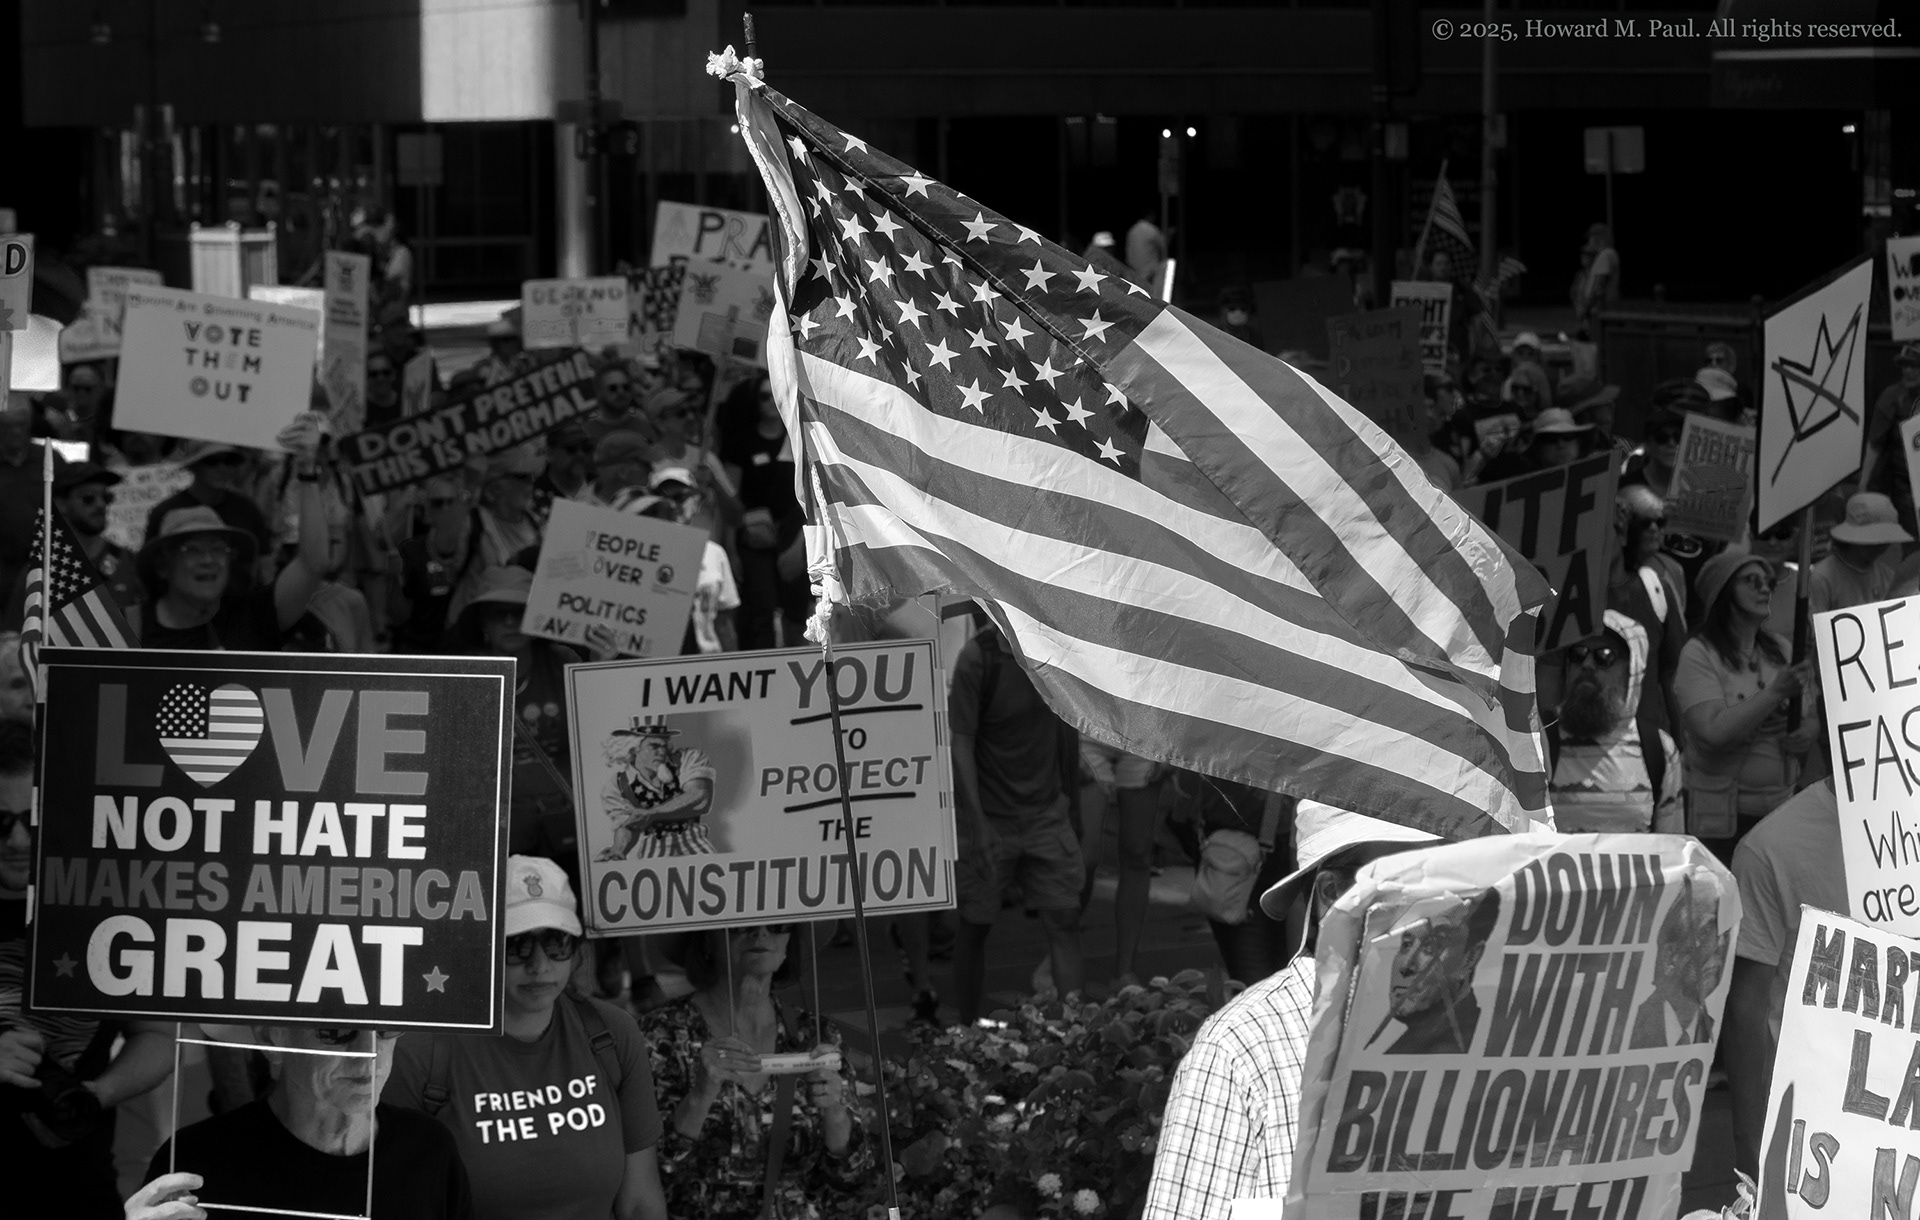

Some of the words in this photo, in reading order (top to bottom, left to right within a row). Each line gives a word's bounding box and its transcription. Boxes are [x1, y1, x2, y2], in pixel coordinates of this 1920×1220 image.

[184, 320, 261, 347] VOTE
[185, 348, 261, 374] THEM
[190, 376, 251, 403] OUT
[354, 449, 430, 492] THIS
[432, 437, 463, 469] IS
[465, 387, 597, 452] NORMAL
[593, 556, 643, 585] OVER
[558, 592, 648, 626] POLITICS
[642, 678, 651, 707] I
[665, 669, 776, 706] WANT
[787, 652, 915, 709] YOU
[760, 755, 932, 797] PROTECT
[92, 795, 235, 853] NOT
[252, 800, 427, 860] HATE
[819, 816, 872, 841] THE
[43, 856, 229, 912] MAKES
[241, 864, 487, 921] AMERICA
[599, 846, 937, 924] CONSTITUTION
[1505, 852, 1666, 947] DOWN
[1863, 884, 1920, 922] are
[86, 914, 424, 1006] GREAT
[1483, 951, 1645, 1057] WITH
[474, 1085, 562, 1113] FRIEND
[568, 1074, 597, 1098] OF
[476, 1117, 538, 1144] THE
[547, 1103, 606, 1135] POD
[1326, 1058, 1705, 1173] BILLIONAIRES
